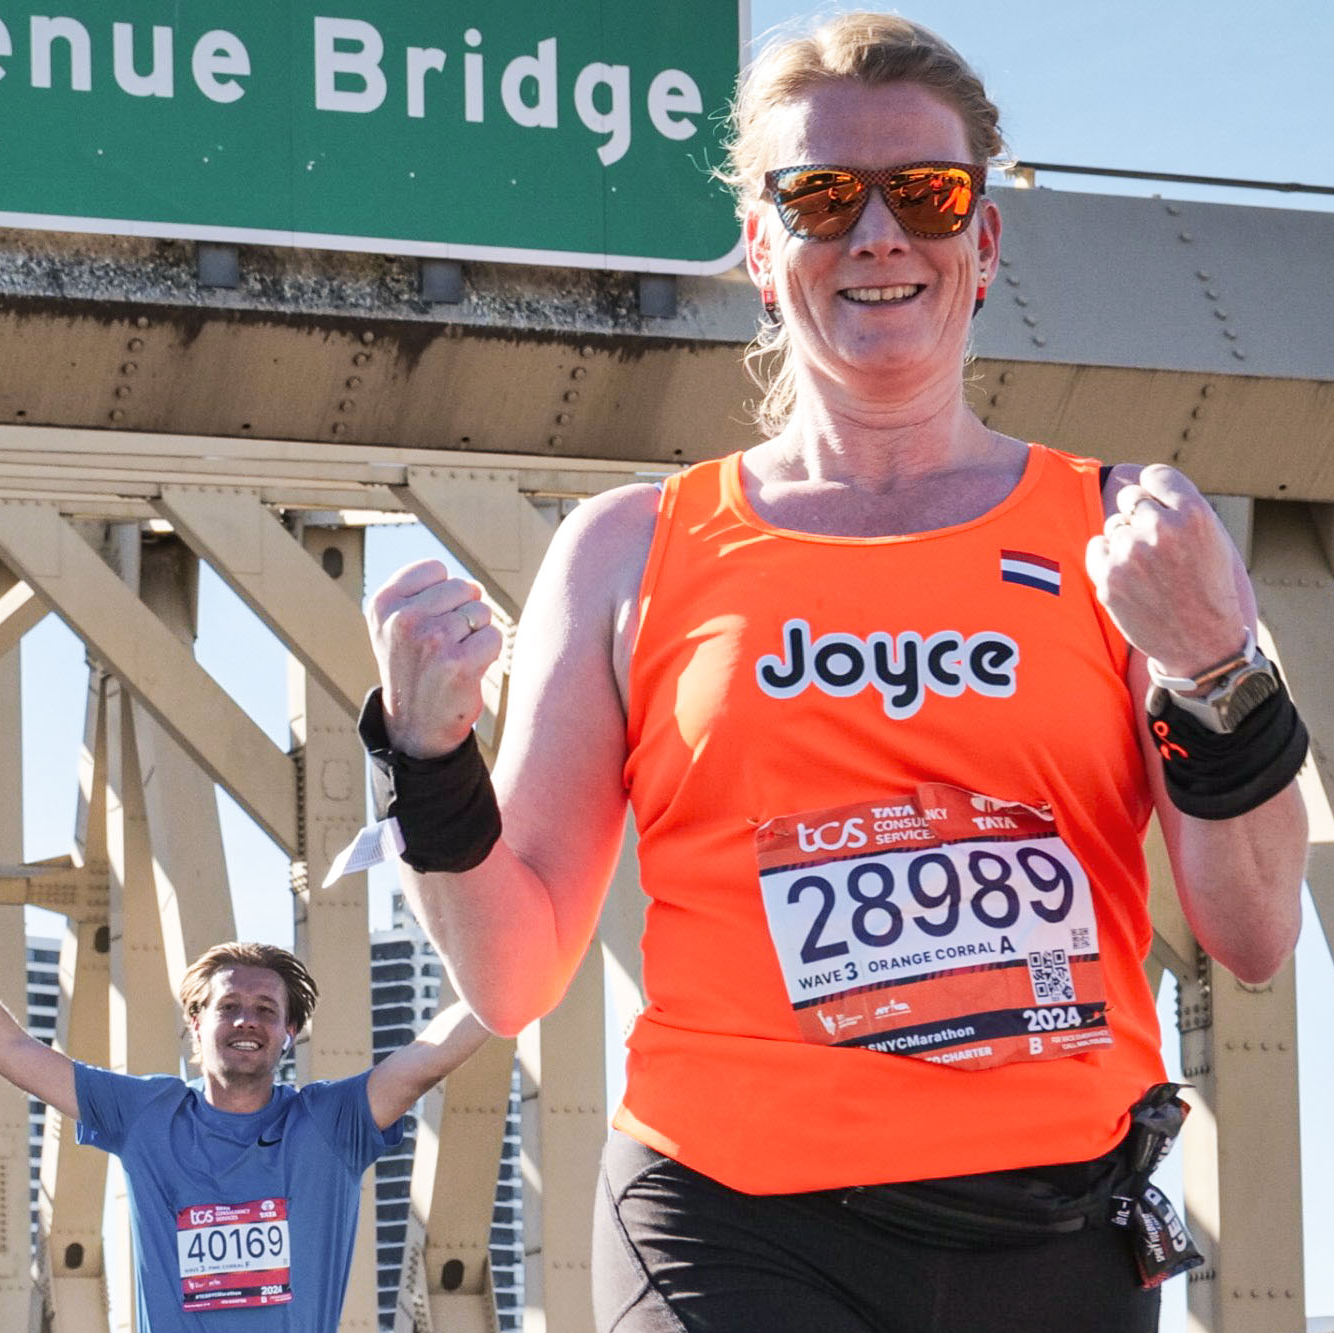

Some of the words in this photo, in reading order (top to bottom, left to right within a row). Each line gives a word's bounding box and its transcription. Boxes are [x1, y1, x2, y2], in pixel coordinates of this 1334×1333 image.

[313, 15, 704, 168] Bridge
[758, 622, 1018, 718] Joyce
[871, 804, 915, 819] TATA
[971, 815, 1019, 831] TATA
[797, 817, 868, 852] tcs
[875, 829, 936, 846] SERVICE
[786, 846, 1075, 965] 28989
[798, 968, 843, 990] WAVE
[843, 961, 859, 981] 3
[868, 950, 933, 973] ORANGE
[934, 941, 996, 961] CORRAL
[999, 935, 1017, 955] A
[1023, 1006, 1082, 1032] 2024
[1028, 1036, 1044, 1056] B
[190, 1208, 214, 1226] tcs
[187, 1225, 283, 1263] 40169
